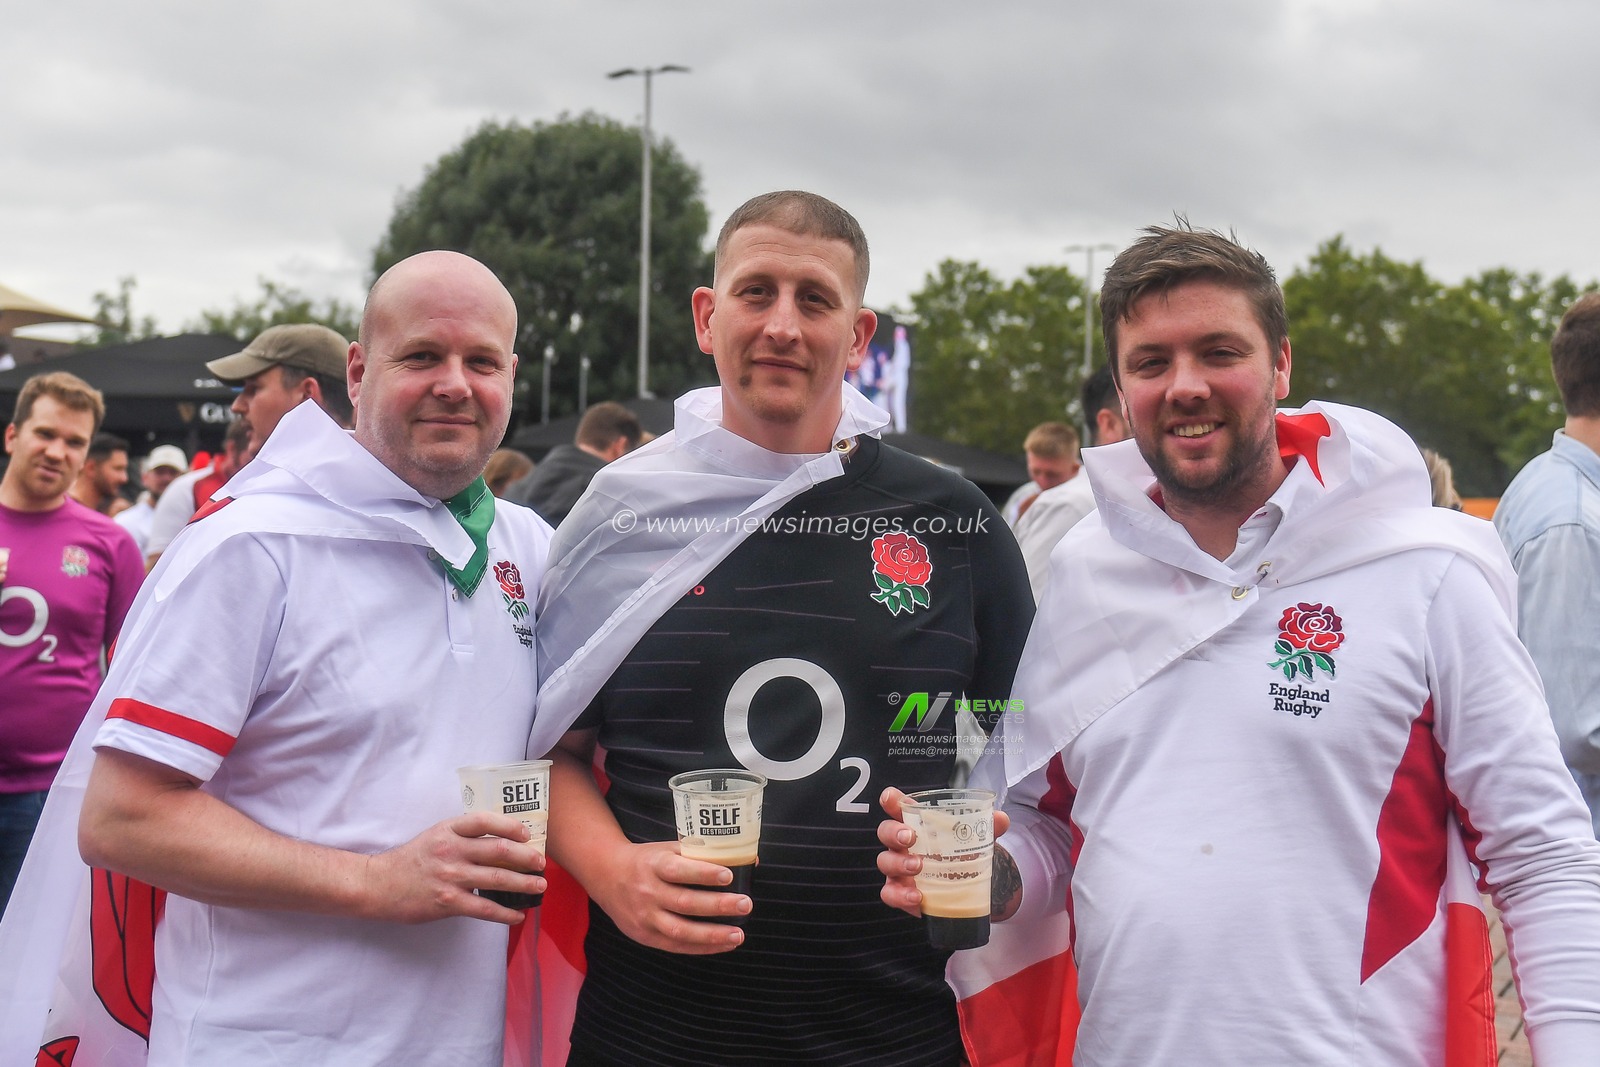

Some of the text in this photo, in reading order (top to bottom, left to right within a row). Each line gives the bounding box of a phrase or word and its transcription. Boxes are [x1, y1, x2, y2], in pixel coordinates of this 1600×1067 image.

[1268, 683, 1330, 703] England
[1273, 698, 1322, 718] Rugby
[724, 657, 871, 813] O2
[502, 782, 540, 803] SELF
[504, 802, 540, 813] DESTRUCTS
[699, 807, 741, 826] SELF
[702, 827, 739, 835] DESTRUCTS
